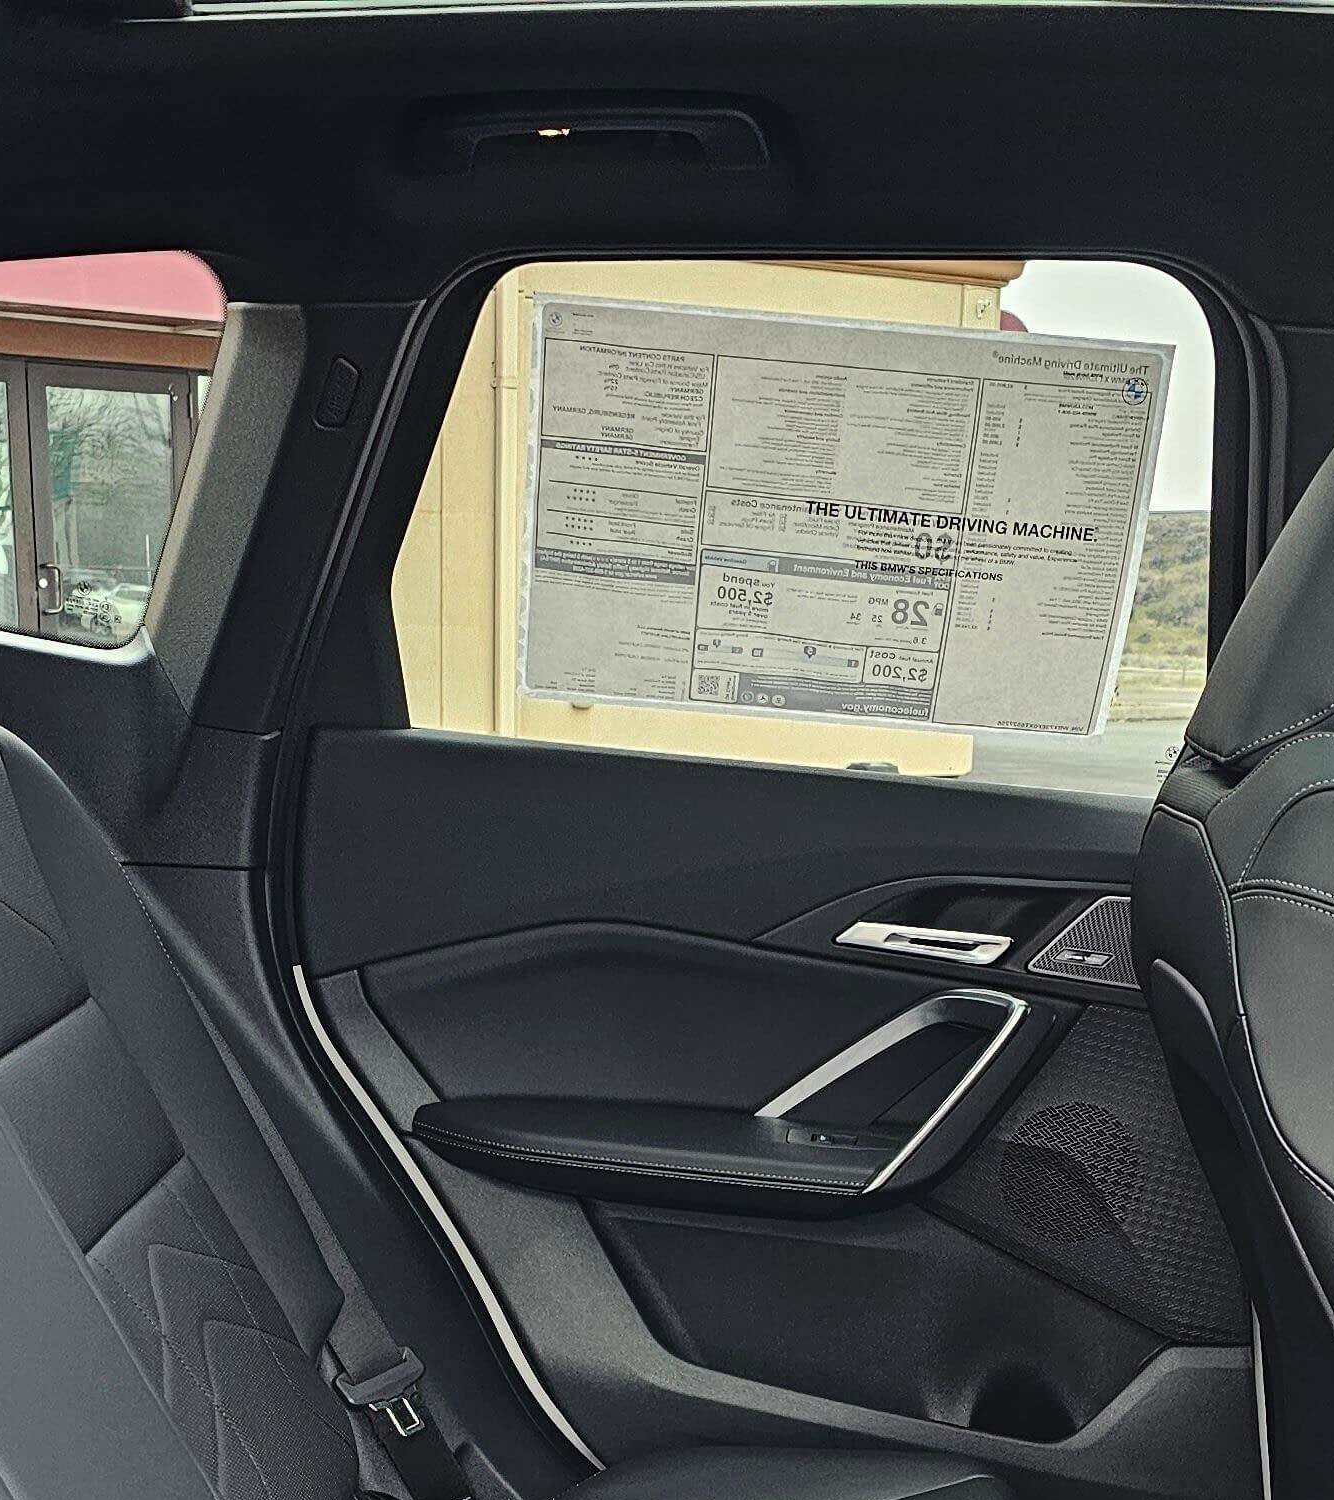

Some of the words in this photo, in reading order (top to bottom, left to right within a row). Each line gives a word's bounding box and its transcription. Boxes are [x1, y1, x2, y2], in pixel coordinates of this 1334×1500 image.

[805, 500, 840, 518] THE
[844, 504, 931, 528] ULTIMATE
[936, 514, 1008, 534] DRIVING
[855, 560, 878, 570] THIS
[881, 562, 916, 574] BMW'S
[917, 566, 1003, 582] SPECIFICATIONS
